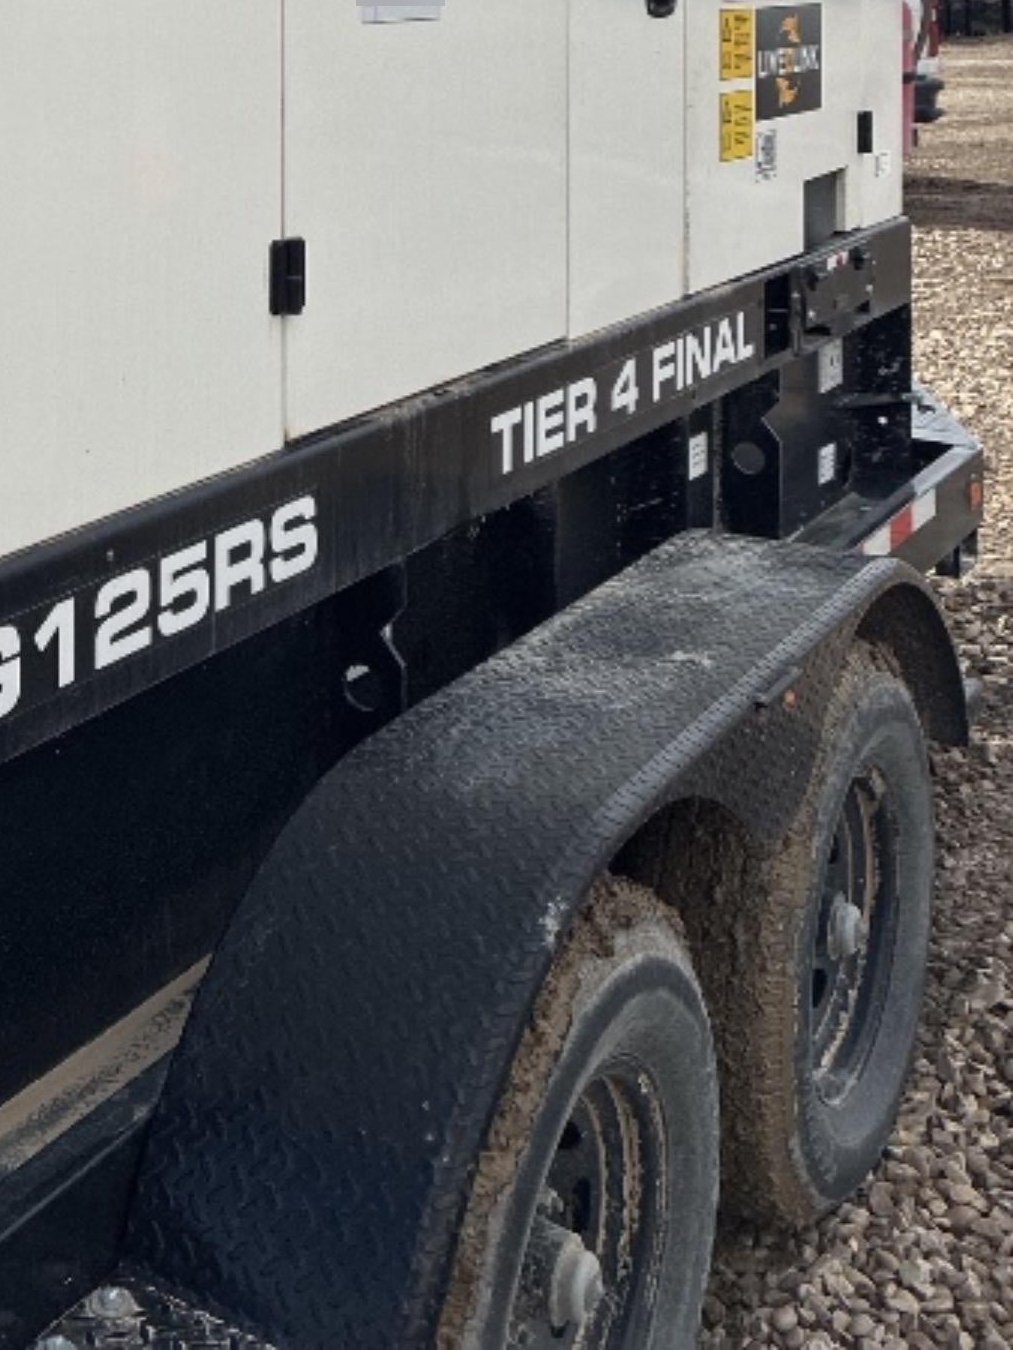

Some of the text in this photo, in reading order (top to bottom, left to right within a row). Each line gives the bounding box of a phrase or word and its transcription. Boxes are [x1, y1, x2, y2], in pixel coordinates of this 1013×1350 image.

[490, 376, 598, 476] TIER
[610, 356, 639, 415] 4
[652, 310, 755, 403] FINAL
